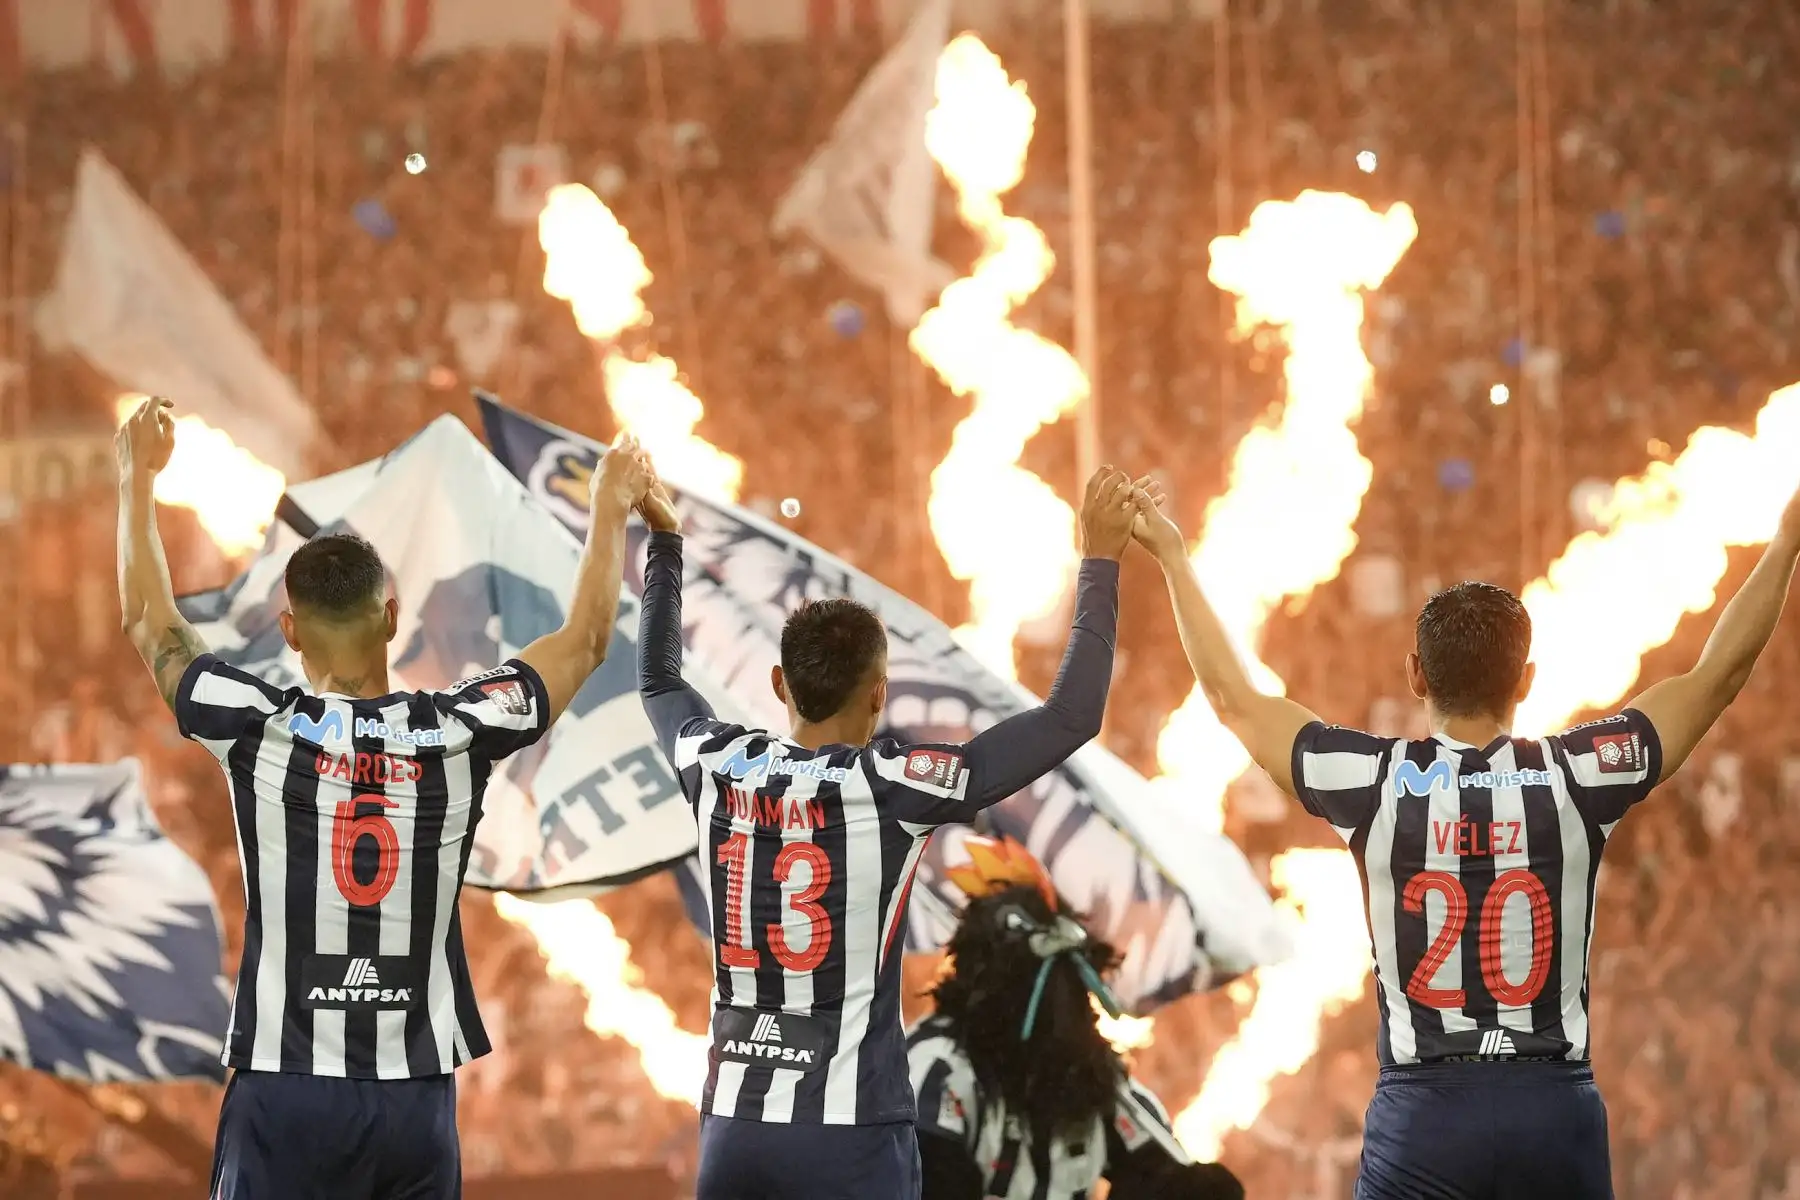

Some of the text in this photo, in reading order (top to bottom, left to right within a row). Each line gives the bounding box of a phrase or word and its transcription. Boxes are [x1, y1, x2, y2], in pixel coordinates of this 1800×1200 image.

[770, 757, 847, 783] Movista
[1461, 769, 1552, 788] Movistar
[724, 785, 826, 830] HUAMAN
[331, 793, 400, 907] 6
[1433, 813, 1523, 856] VÉLEZ
[716, 832, 832, 972] 13
[1402, 869, 1554, 1009] 20
[307, 986, 411, 1002] ANYPSA
[722, 1039, 813, 1064] ANYPSA
